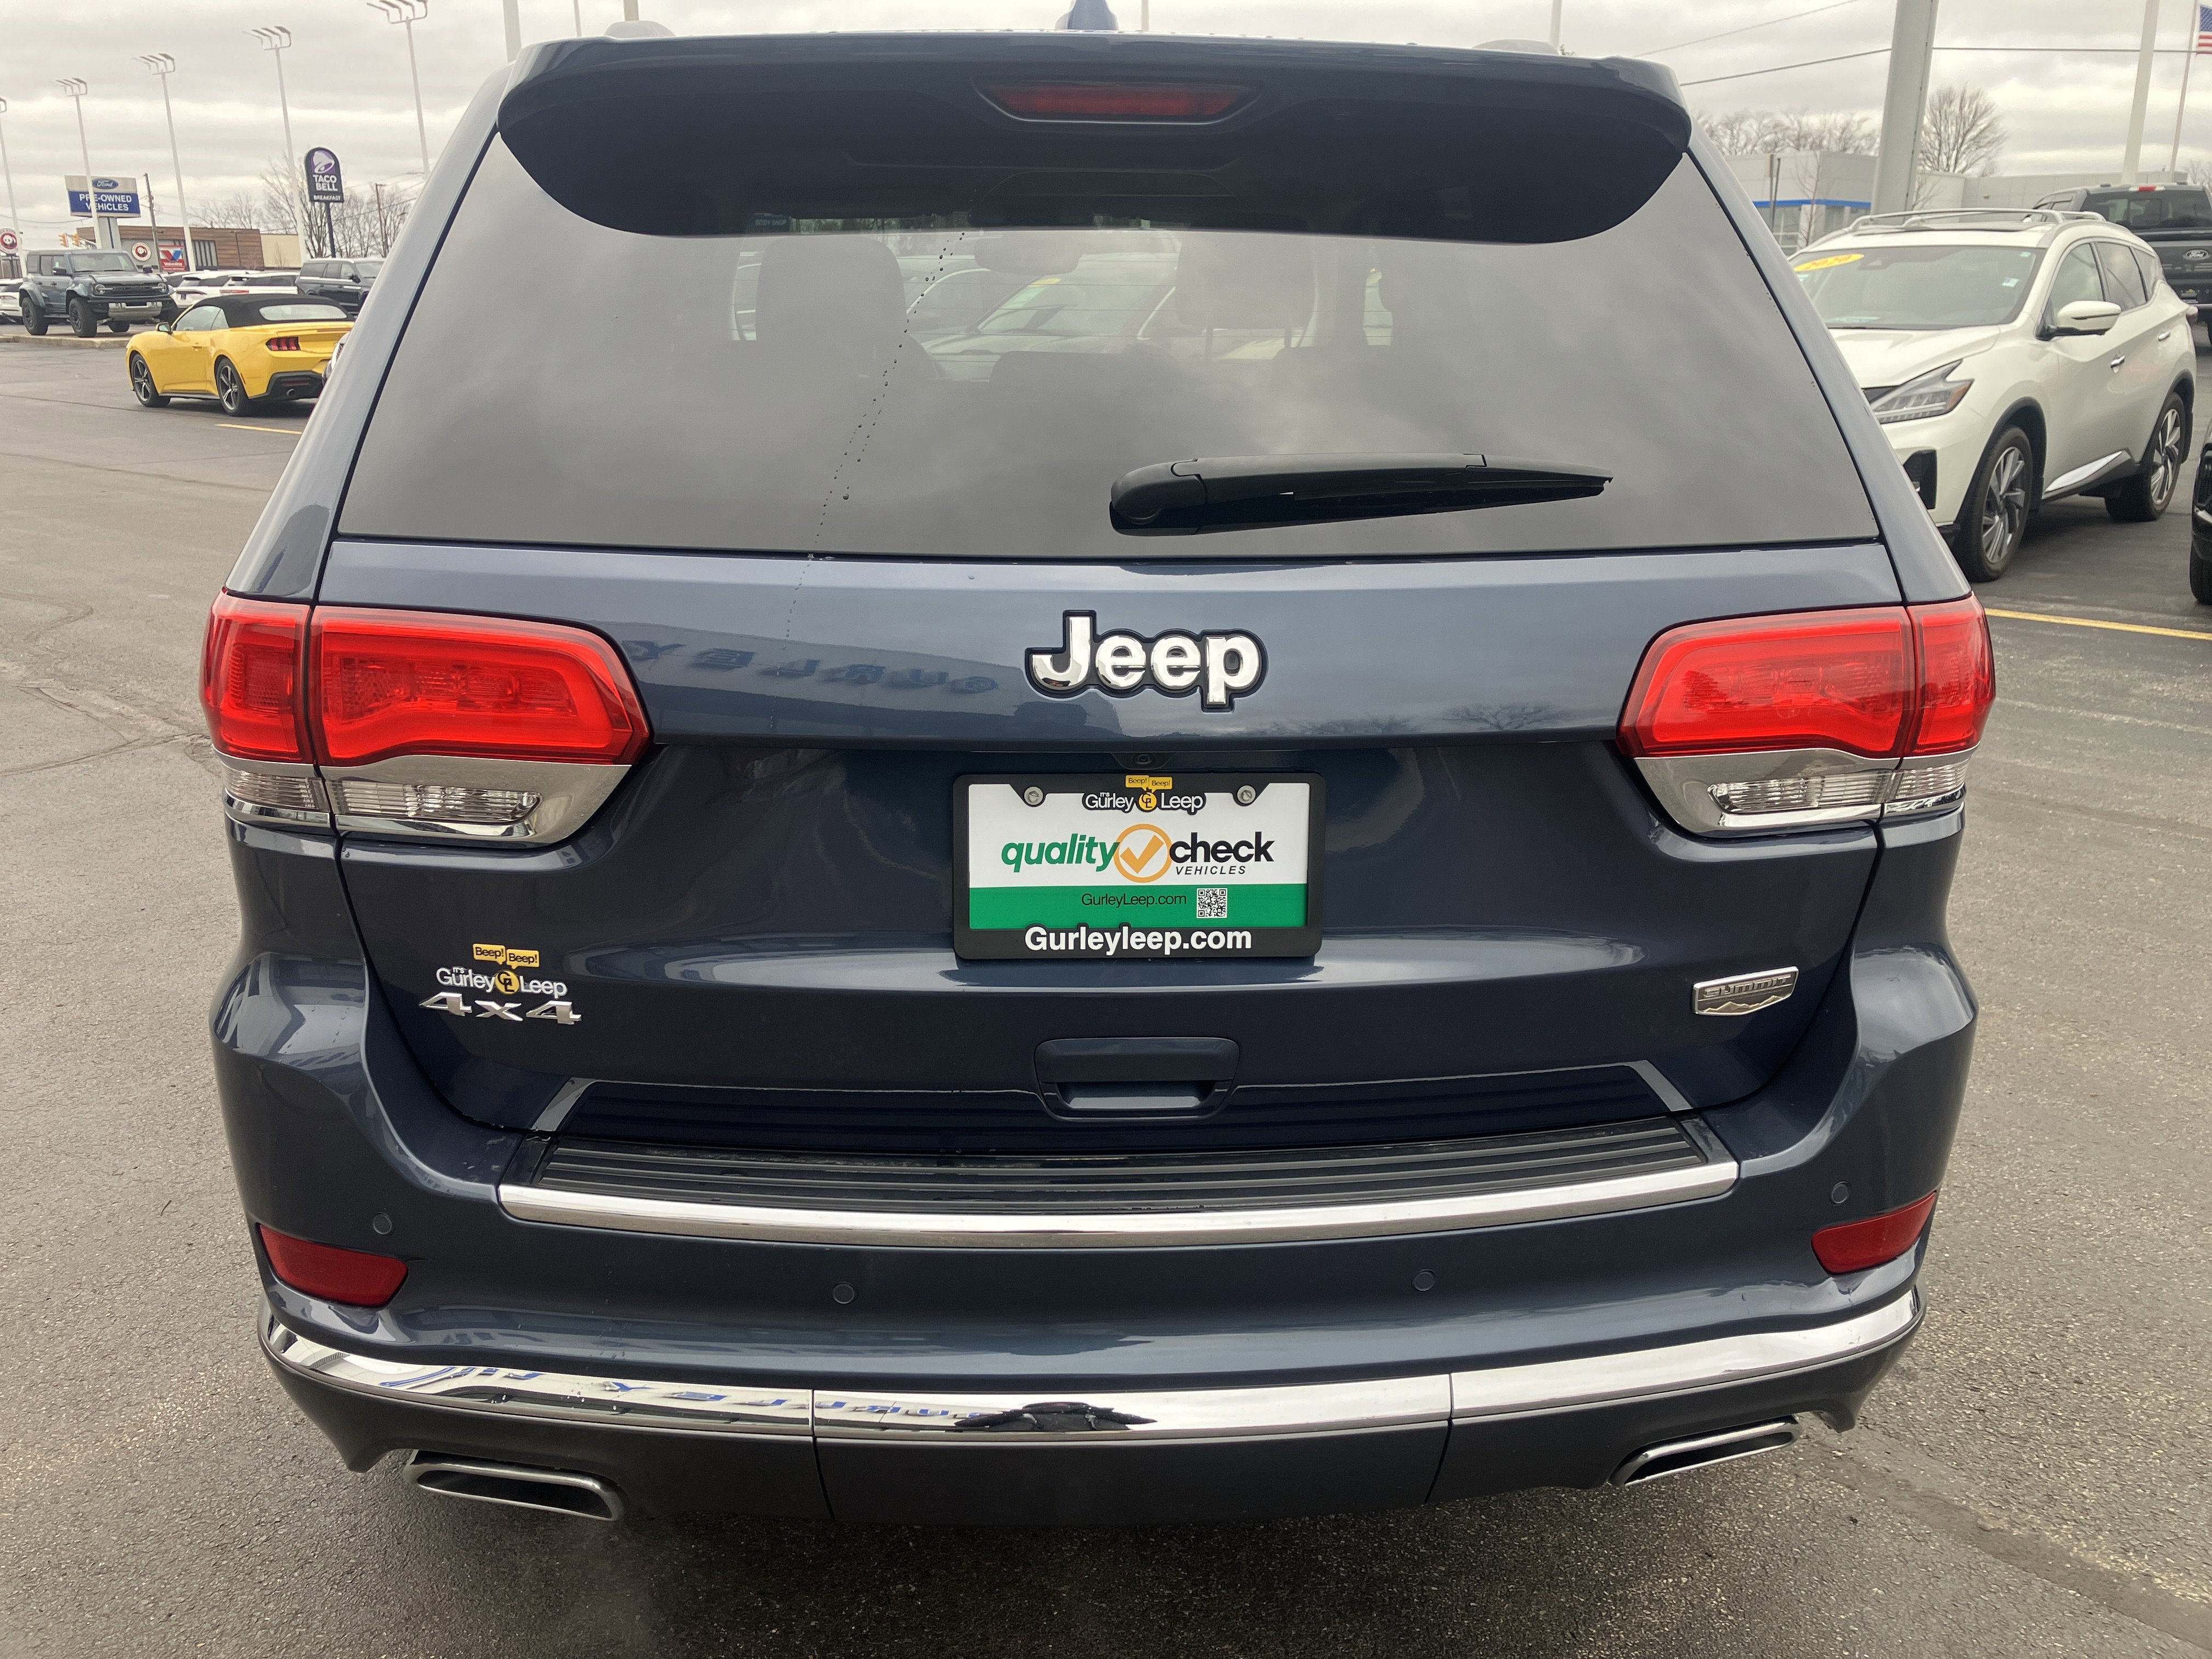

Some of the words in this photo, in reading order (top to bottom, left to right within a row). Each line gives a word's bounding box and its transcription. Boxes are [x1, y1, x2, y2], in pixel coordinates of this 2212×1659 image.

[313, 174, 337, 183] TACO
[316, 183, 338, 191] BELL
[1029, 614, 1263, 707] Jeep
[1086, 793, 1134, 811] Gurley
[1161, 792, 1203, 812] Leep
[1001, 833, 1120, 873] quality
[1169, 832, 1275, 862] check
[1176, 866, 1246, 874] VEHICLES
[1081, 893, 1187, 908] GurleyLeep.com
[1025, 926, 1251, 955] Gurleyleep.com
[476, 947, 504, 958] Beep!
[509, 953, 537, 964] Beep!
[436, 968, 495, 992] Gurley
[520, 975, 568, 1000] Leep
[1703, 974, 1791, 998] SUMMIT
